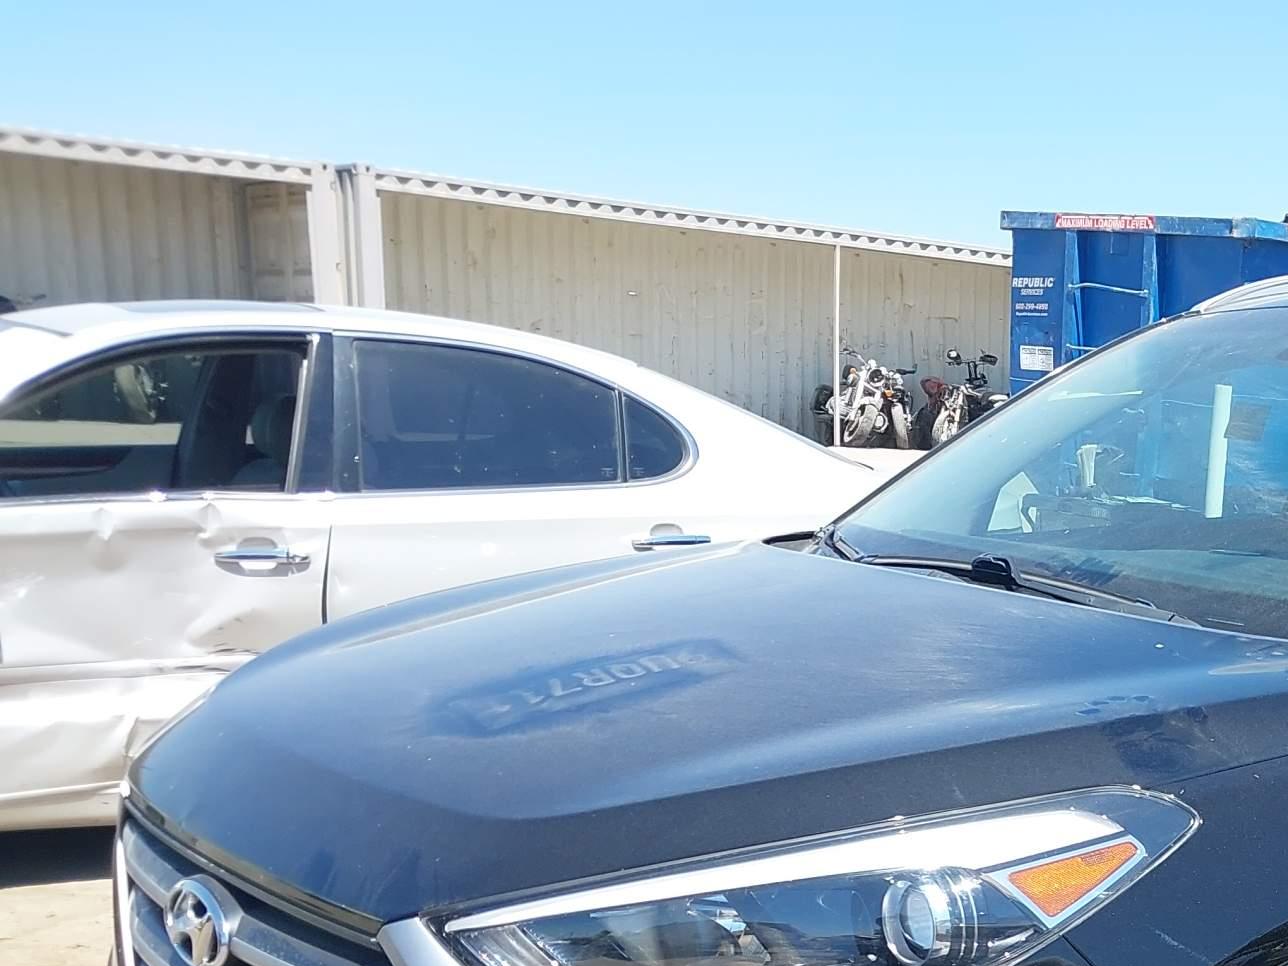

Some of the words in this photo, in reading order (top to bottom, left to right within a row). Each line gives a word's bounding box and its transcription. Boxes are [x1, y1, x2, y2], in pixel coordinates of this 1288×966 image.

[1061, 218, 1092, 228] MAXIMUM
[1094, 219, 1125, 229] LOADING
[1127, 220, 1148, 230] LEVEL
[1012, 277, 1054, 288] REPUBLIC
